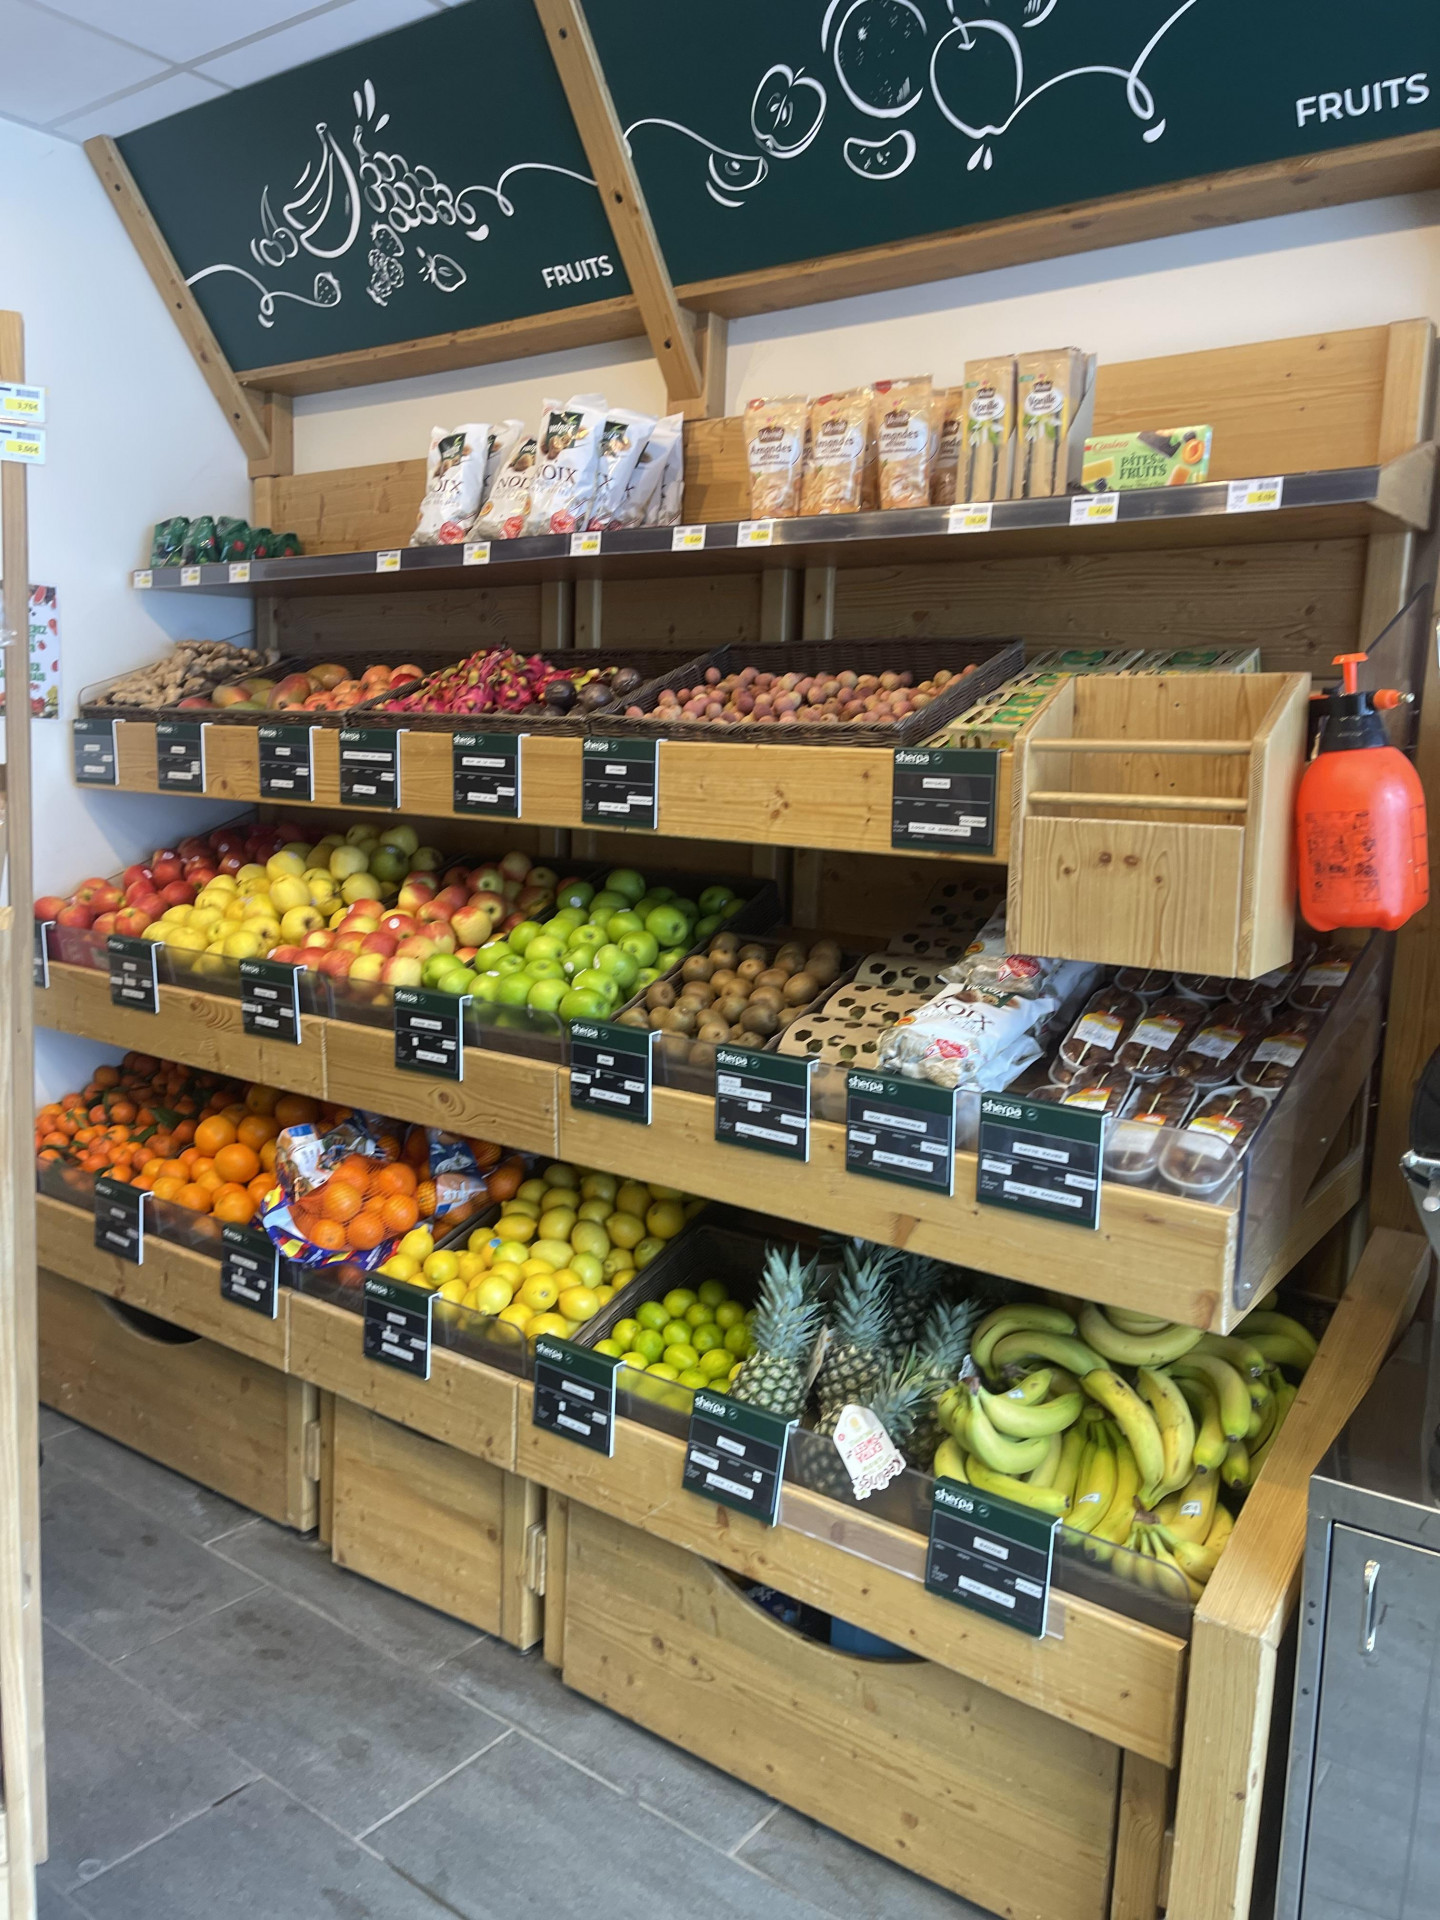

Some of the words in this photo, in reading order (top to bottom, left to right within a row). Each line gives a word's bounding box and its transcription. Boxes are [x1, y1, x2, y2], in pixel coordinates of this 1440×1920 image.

[1295, 72, 1430, 128] FRUITS
[541, 254, 614, 289] FRUITS
[1120, 452, 1159, 468] PÂTES
[1119, 464, 1168, 480] FRUITS
[894, 750, 930, 764] sherpa
[716, 1051, 748, 1067] sherpa
[848, 1076, 884, 1092] sherpa
[982, 1100, 1022, 1118] sherpa
[694, 1396, 726, 1415] sherpa
[934, 1488, 974, 1511] sherpa
